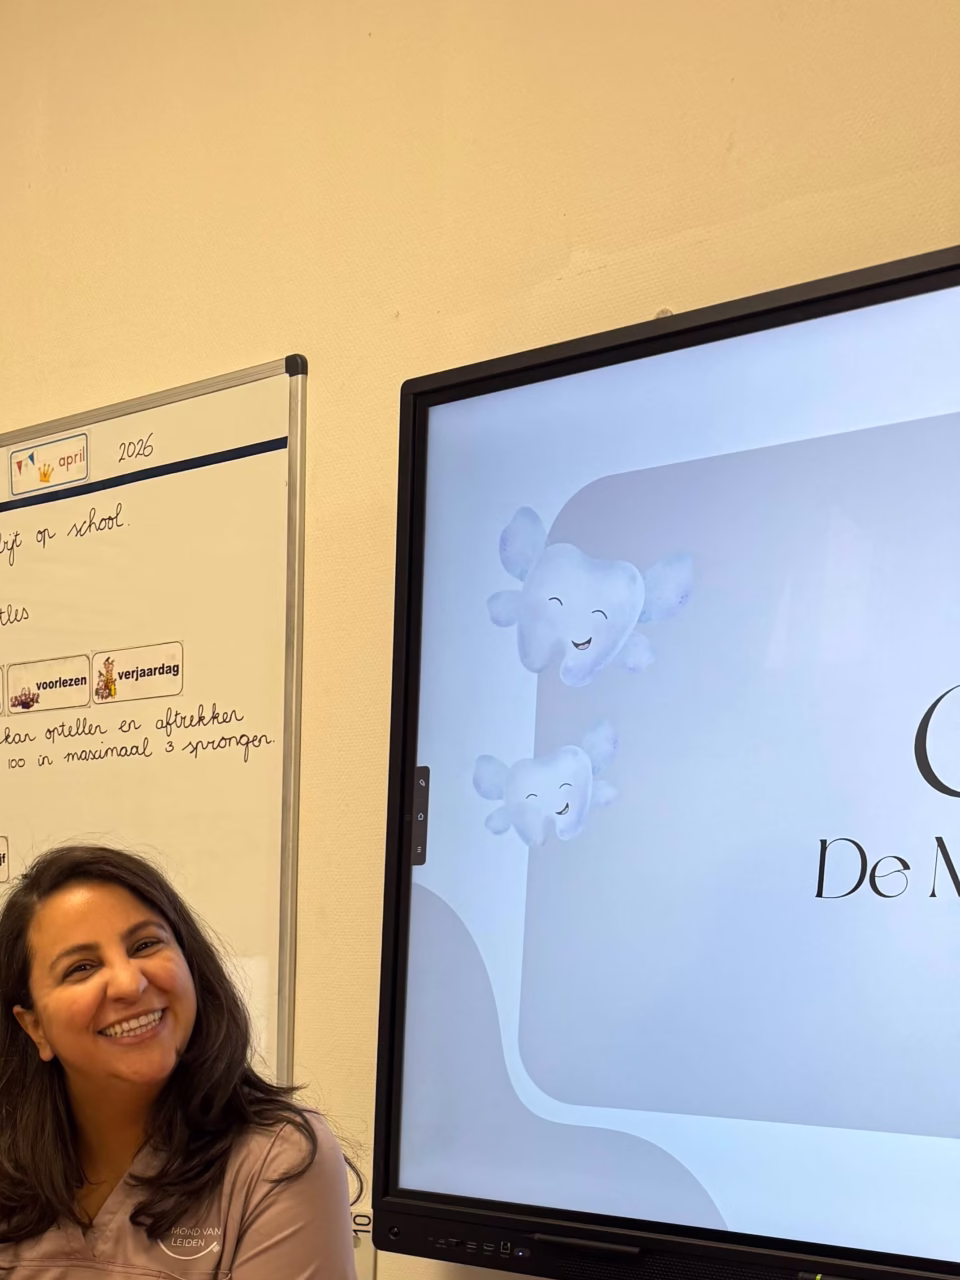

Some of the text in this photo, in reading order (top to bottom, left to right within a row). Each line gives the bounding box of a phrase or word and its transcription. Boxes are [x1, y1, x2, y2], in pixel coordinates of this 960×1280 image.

[118, 432, 154, 462] 2026
[58, 446, 86, 471] april
[36, 528, 56, 549] op
[36, 676, 87, 690] voorlezen
[118, 663, 179, 681] verjaardag
[45, 717, 107, 744] optellen
[118, 719, 142, 733] en
[155, 703, 244, 737] aftrekken
[8, 758, 26, 769] 100
[38, 754, 53, 767] in
[64, 737, 152, 762] maximaal
[165, 741, 174, 753] 3
[814, 837, 911, 899] De
[171, 1226, 221, 1236] MOND VAN
[352, 1214, 371, 1236] 10
[171, 1238, 205, 1246] LEIDEN
